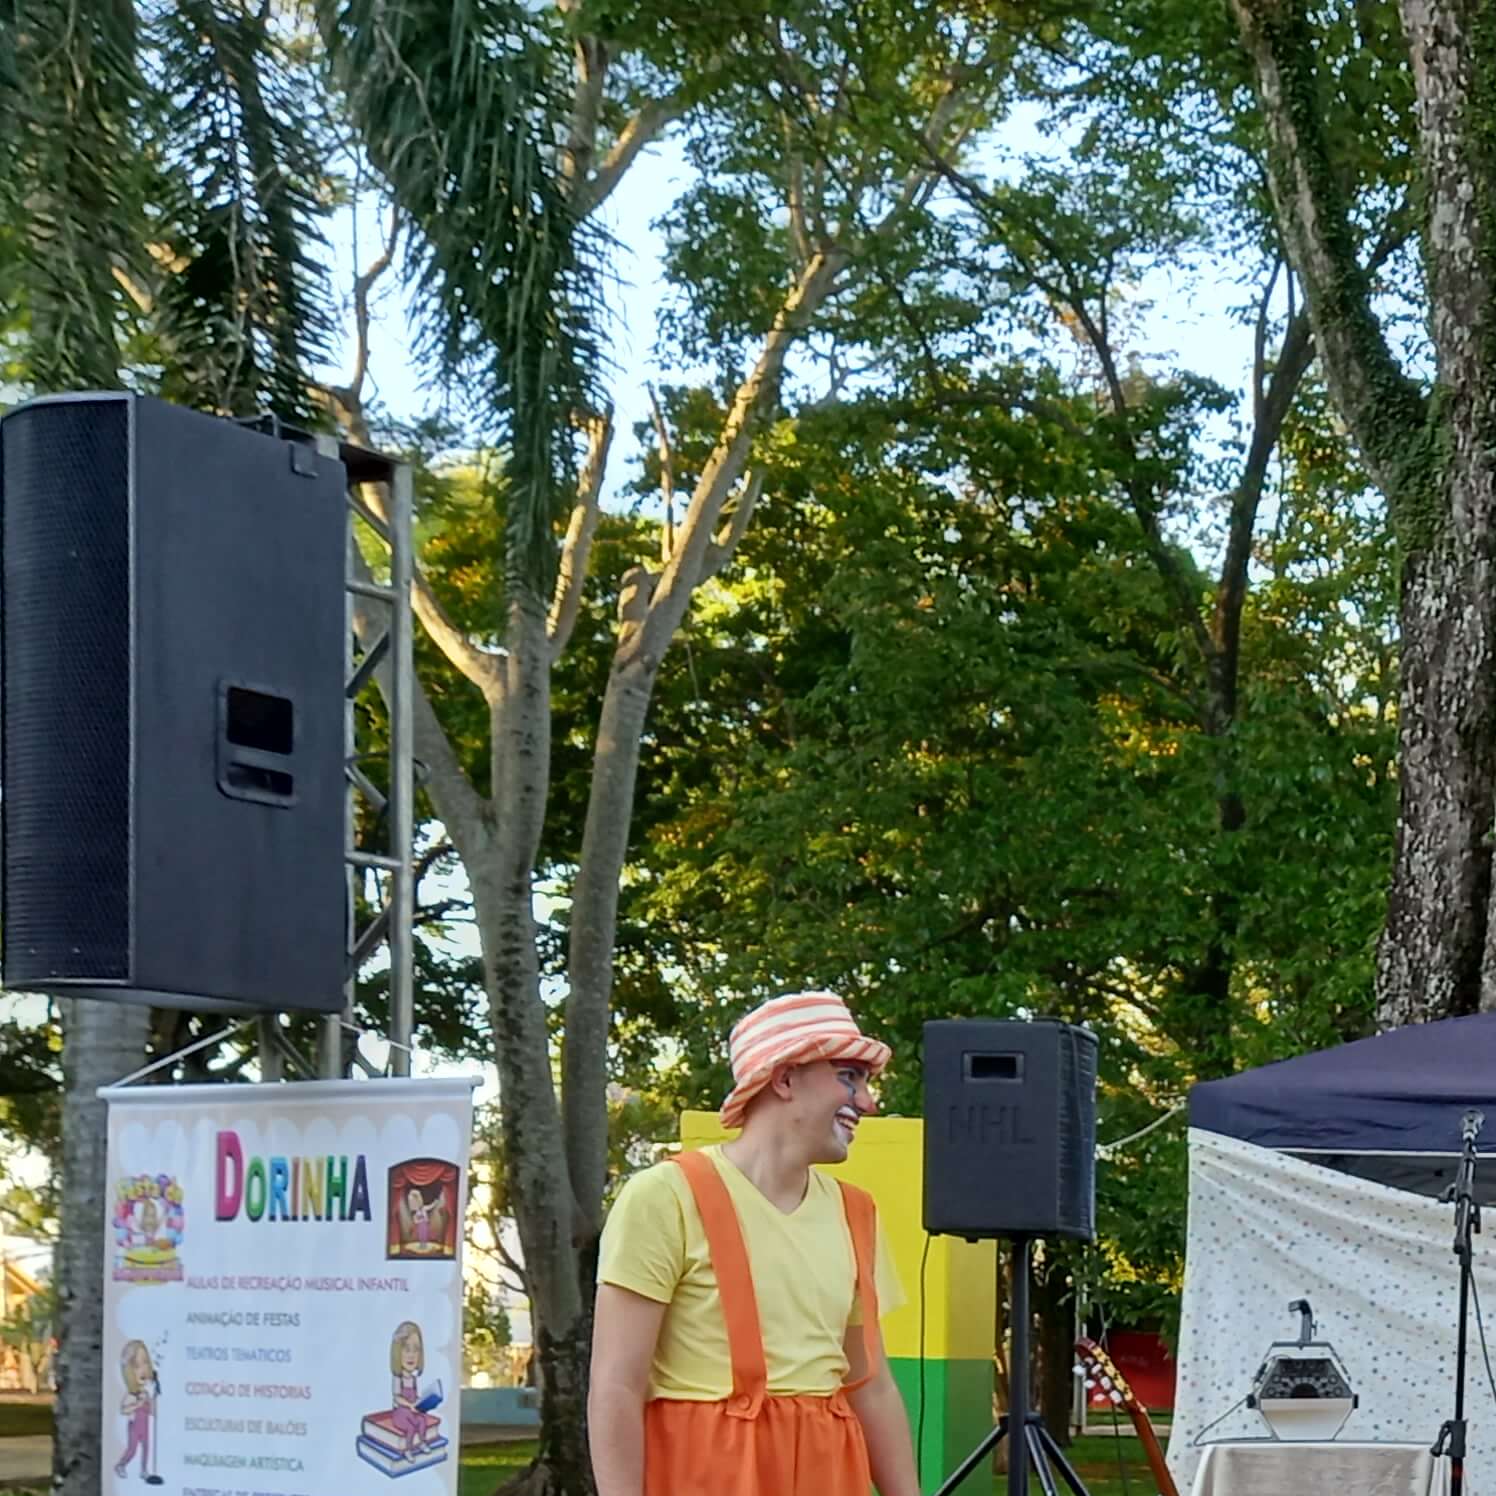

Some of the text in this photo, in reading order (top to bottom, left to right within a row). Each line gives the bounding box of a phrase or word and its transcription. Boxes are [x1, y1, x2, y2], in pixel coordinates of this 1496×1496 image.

[215, 1130, 372, 1222] DORINHA
[186, 1276, 219, 1291] AULAS
[221, 1276, 236, 1291] DE
[305, 1277, 355, 1292] MUSICAL
[358, 1277, 409, 1292] INFANTIL
[186, 1311, 301, 1327] ANIMAÇÃO DE FESTAS
[238, 1383, 250, 1397] DE
[247, 1419, 262, 1434] DE
